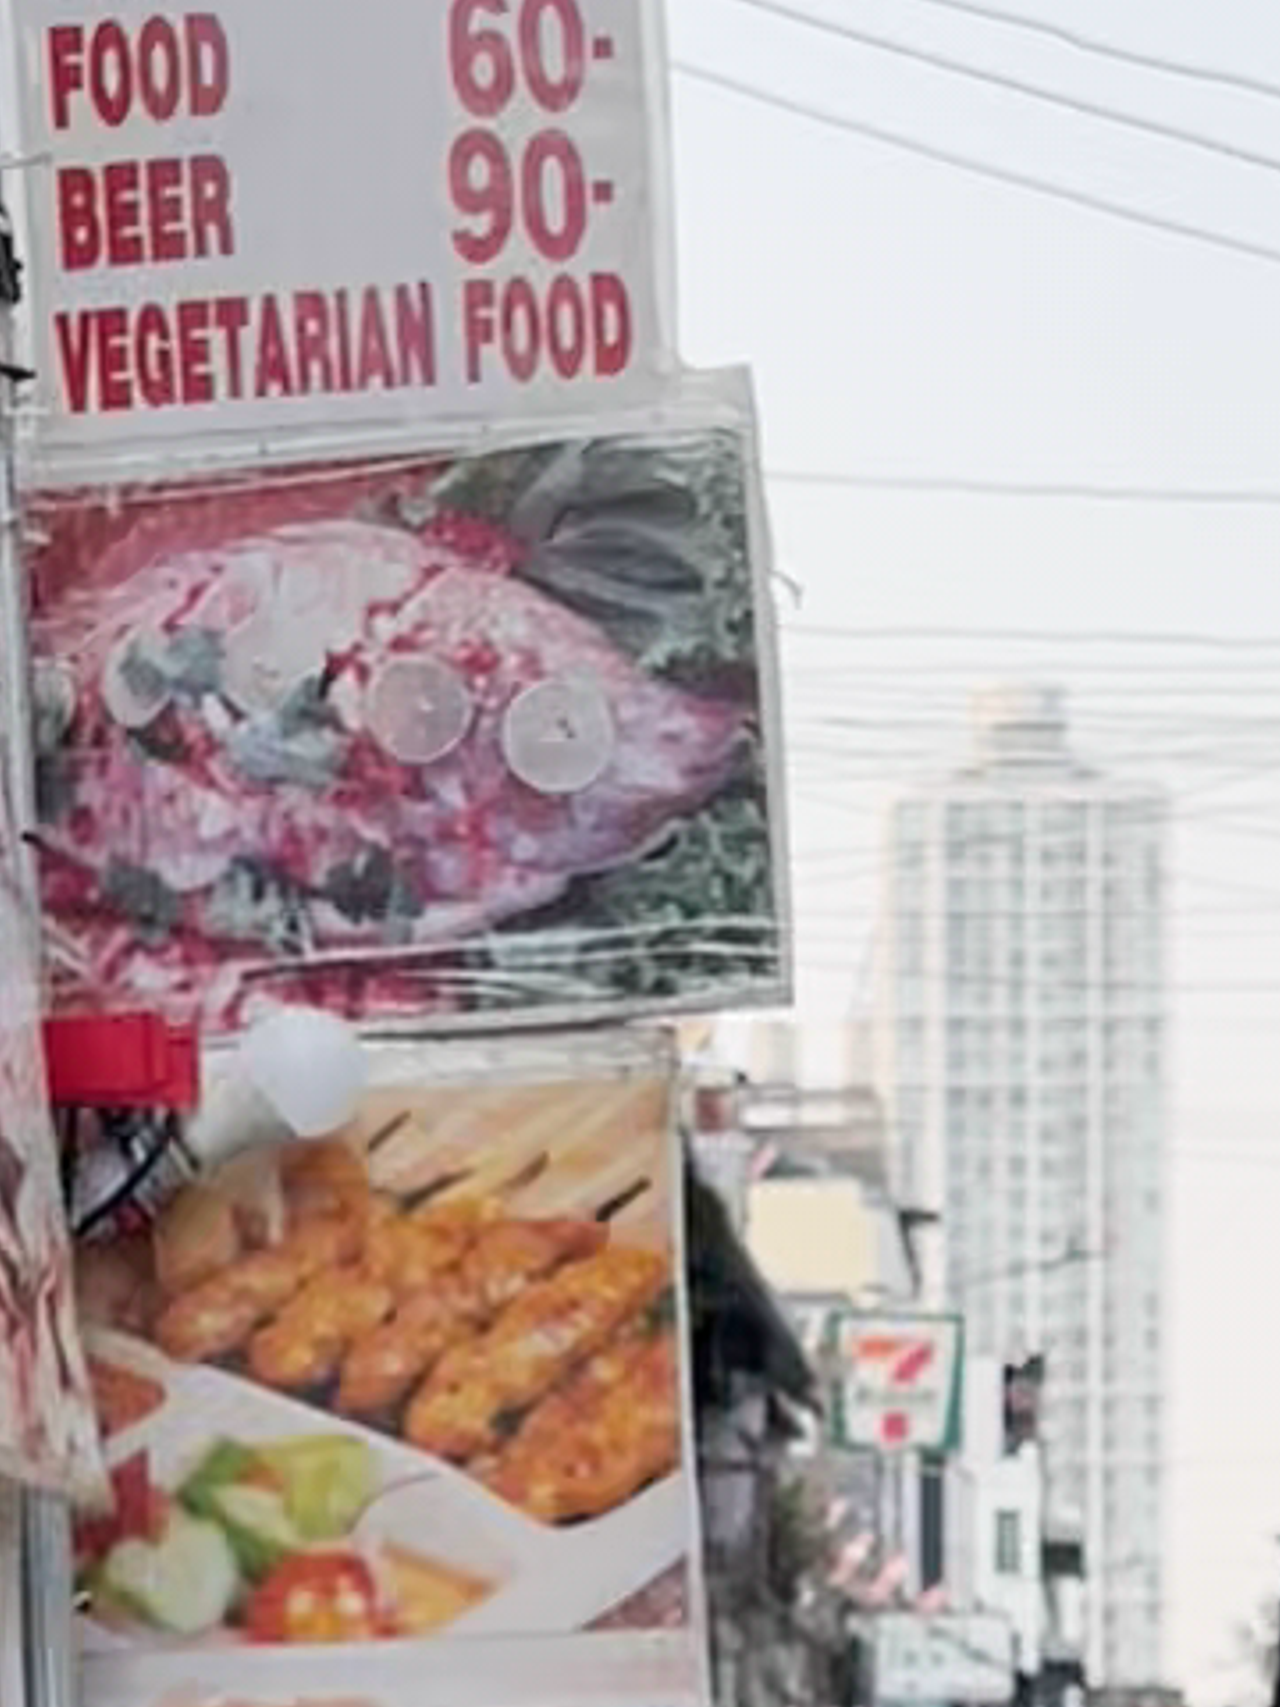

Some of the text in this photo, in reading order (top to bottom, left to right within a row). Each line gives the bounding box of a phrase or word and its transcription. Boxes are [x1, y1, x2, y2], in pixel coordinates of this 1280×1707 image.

[48, 12, 230, 130] FOOD
[56, 154, 234, 272] BEER
[54, 272, 632, 414] VEGETARIAN FOOD
